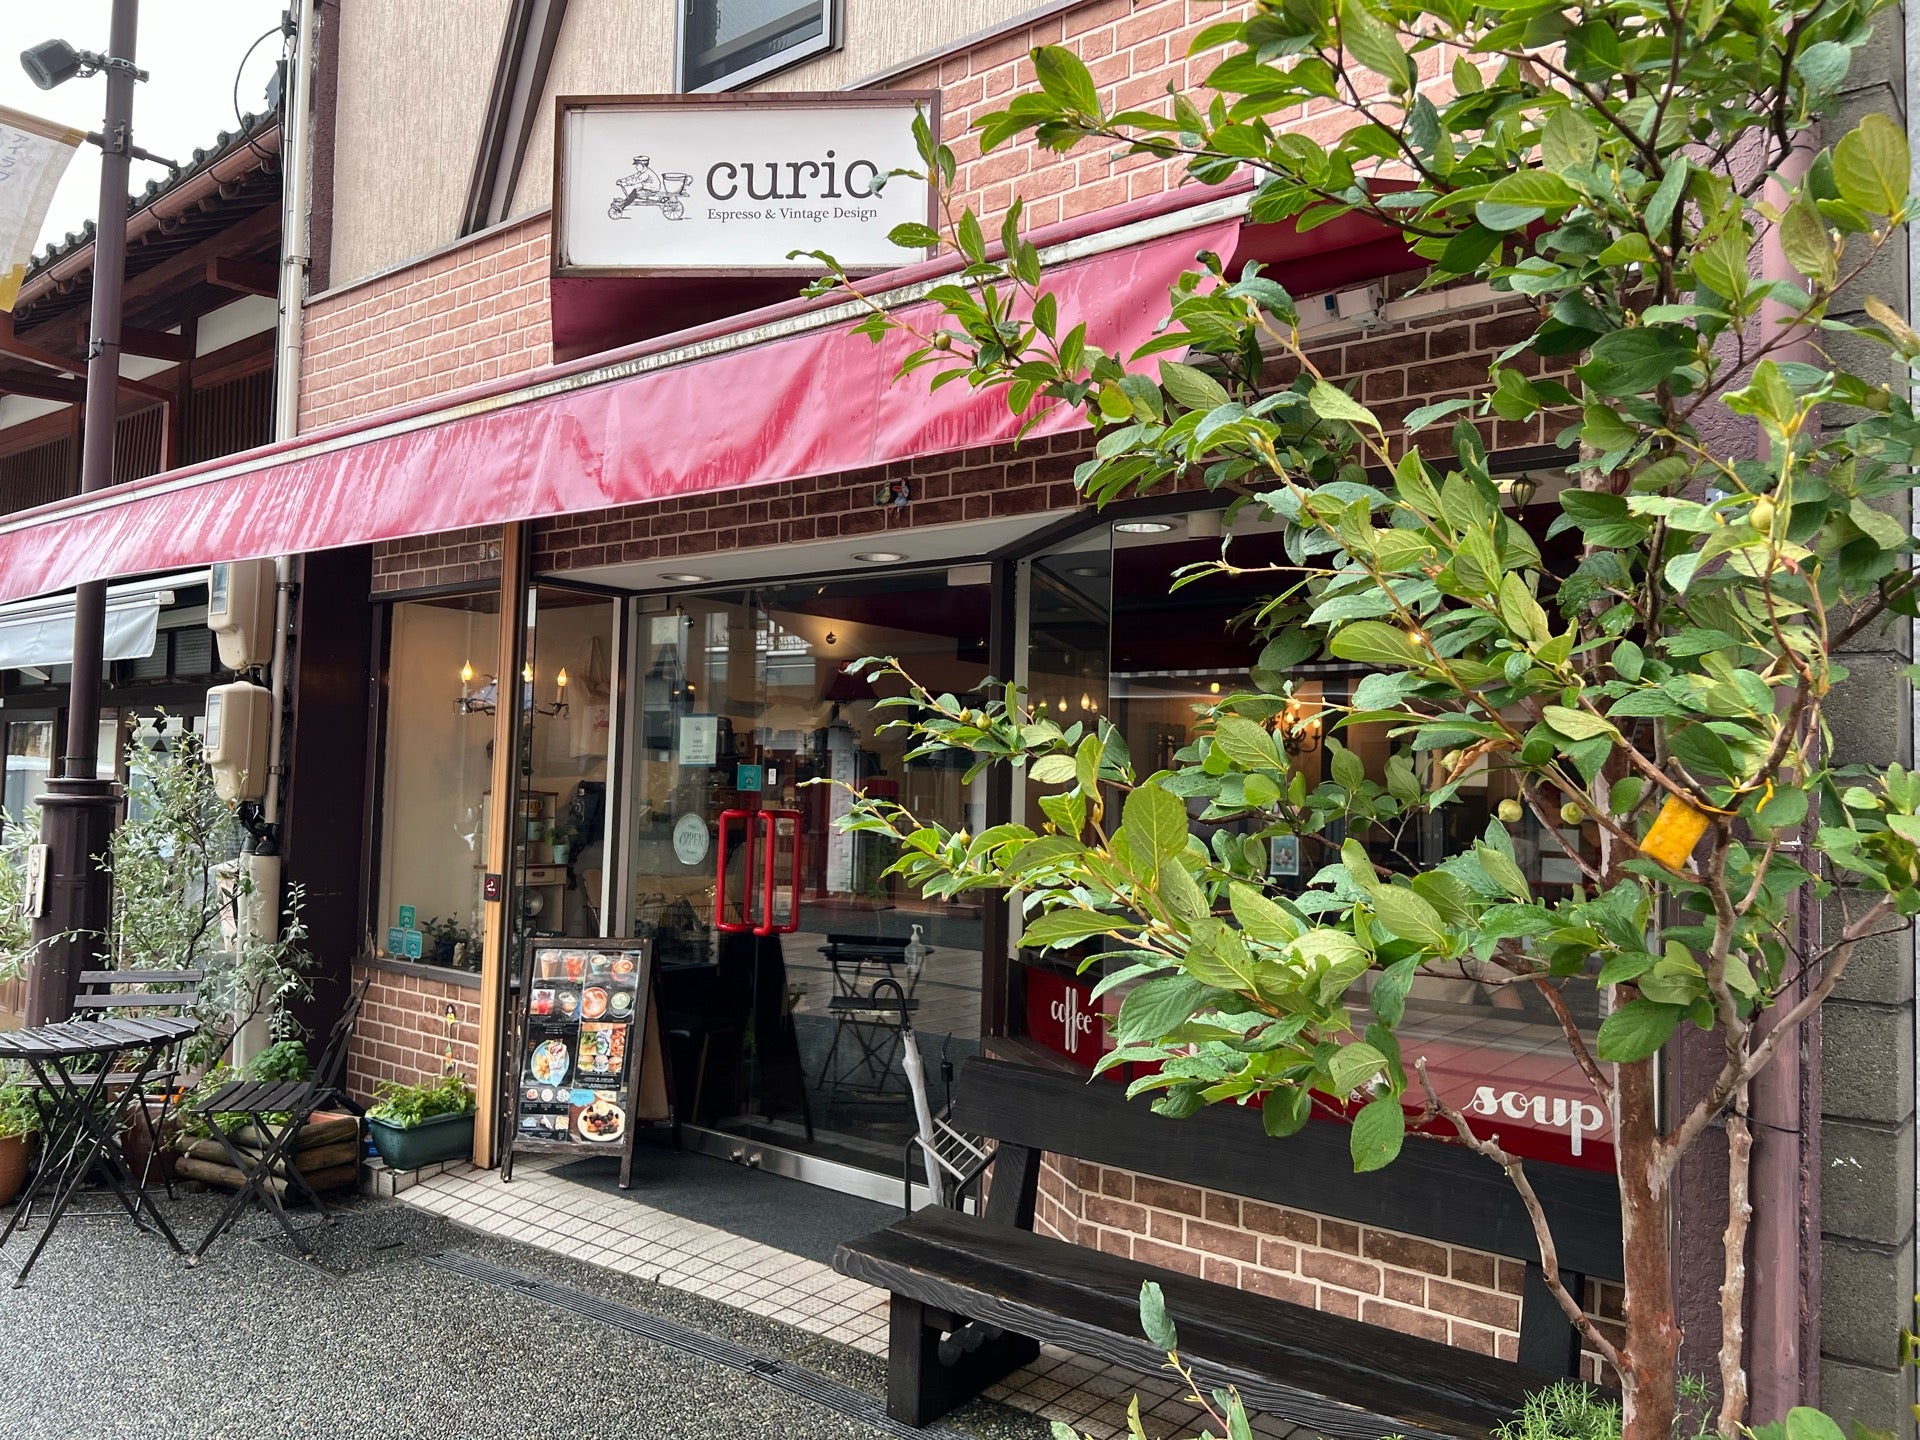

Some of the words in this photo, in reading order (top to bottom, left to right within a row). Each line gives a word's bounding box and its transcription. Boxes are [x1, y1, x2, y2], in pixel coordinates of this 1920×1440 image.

[706, 149, 879, 201] curio
[707, 207, 762, 223] Espresso
[765, 208, 776, 220] &
[779, 207, 830, 223] Vintage
[834, 206, 878, 223] Design
[1050, 986, 1093, 1054] coffee
[1462, 1086, 1604, 1157] soup
